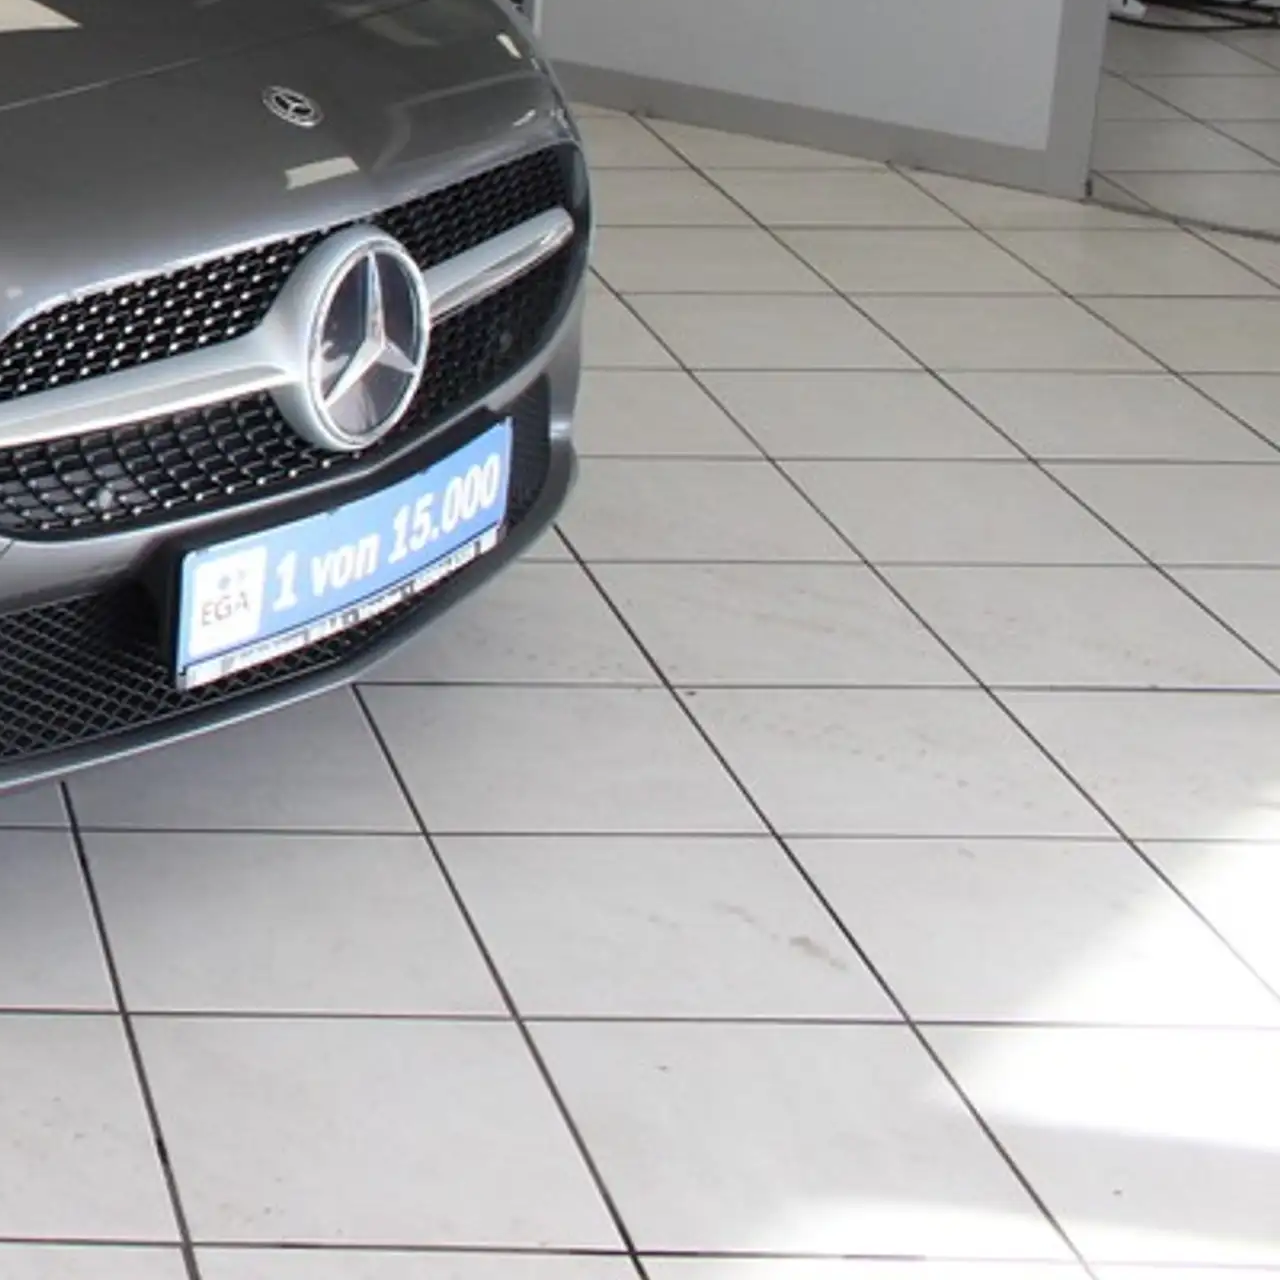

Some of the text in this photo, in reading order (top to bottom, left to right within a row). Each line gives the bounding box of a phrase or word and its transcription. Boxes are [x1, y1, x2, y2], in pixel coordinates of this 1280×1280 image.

[272, 553, 298, 611] 1
[310, 533, 380, 597] von
[388, 452, 502, 565] 15.000
[201, 589, 251, 627] EGA
